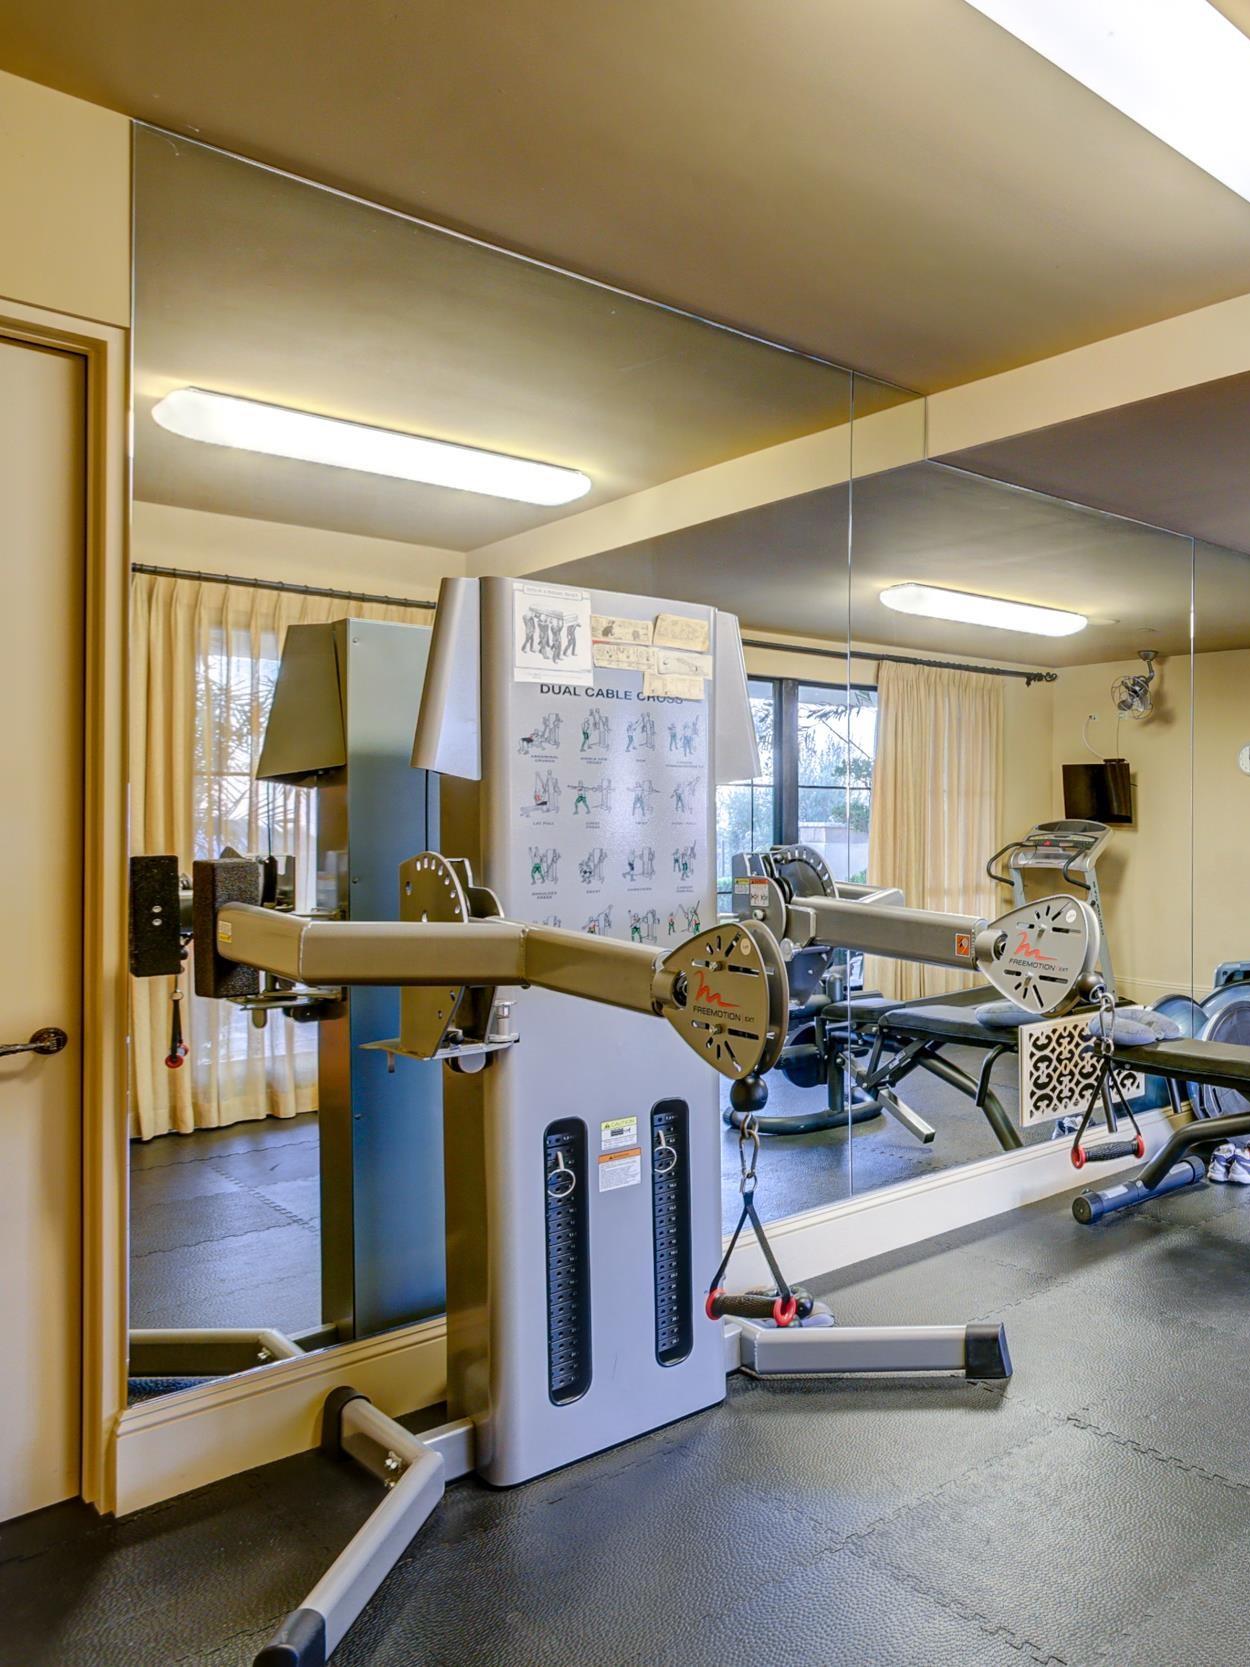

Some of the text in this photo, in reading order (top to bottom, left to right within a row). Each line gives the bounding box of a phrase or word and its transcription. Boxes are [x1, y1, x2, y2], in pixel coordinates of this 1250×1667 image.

[540, 683, 581, 696] DUAL
[585, 687, 632, 700] CABLE
[1009, 958, 1056, 971] FREEMOTION
[692, 1005, 741, 1021] FREEMOTION
[611, 1118, 635, 1128] CAUTION
